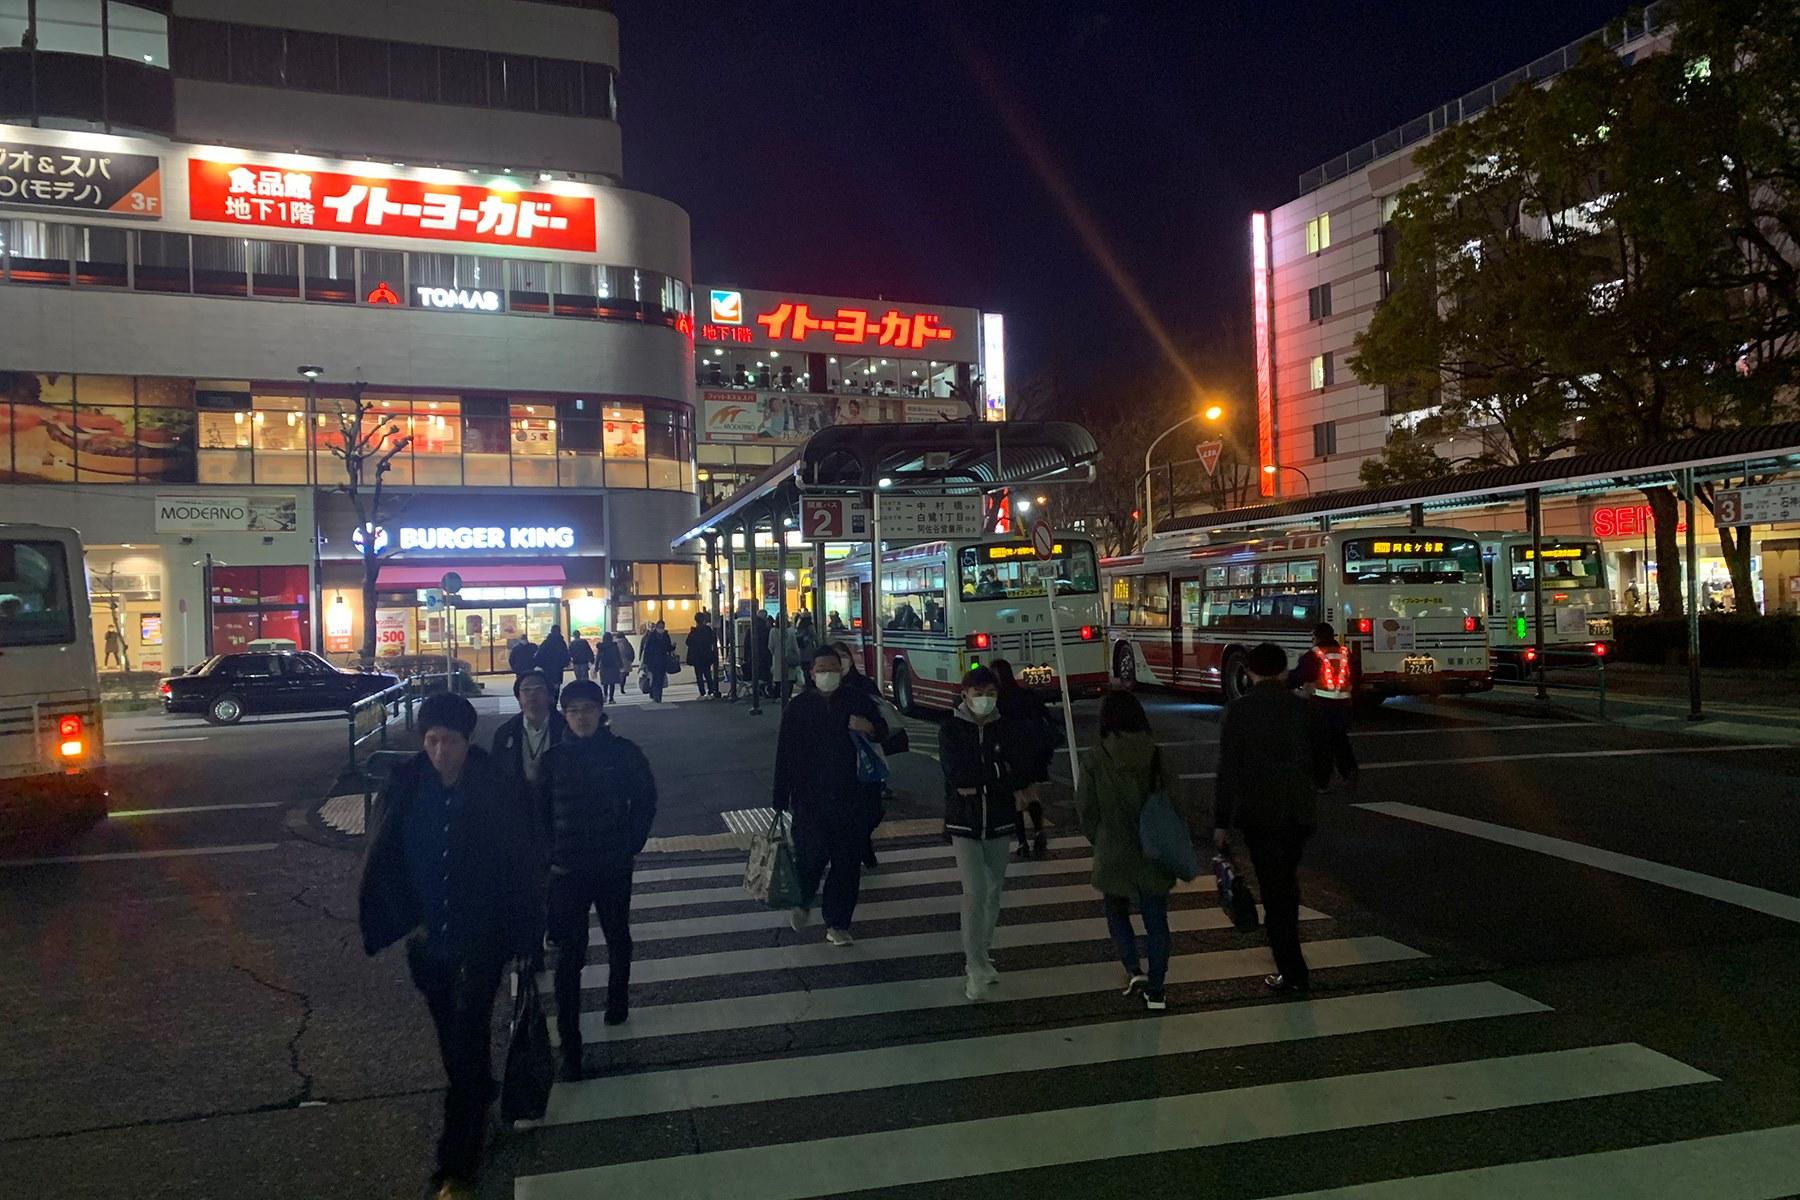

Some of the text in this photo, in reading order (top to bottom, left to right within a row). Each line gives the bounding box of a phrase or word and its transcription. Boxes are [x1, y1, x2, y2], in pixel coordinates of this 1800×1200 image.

[227, 167, 312, 199] 食品館
[131, 192, 158, 211] 3F
[225, 196, 315, 226] 地下1階
[323, 185, 567, 238] イトーヨーカドー
[417, 287, 499, 311] TOMAS
[702, 325, 752, 343] 地下1階
[757, 303, 952, 348] イトーヨーカドー
[161, 507, 244, 519] MODERNO
[813, 509, 833, 536] 2
[1721, 501, 1735, 522] 3
[400, 527, 574, 549] BURGER KING
